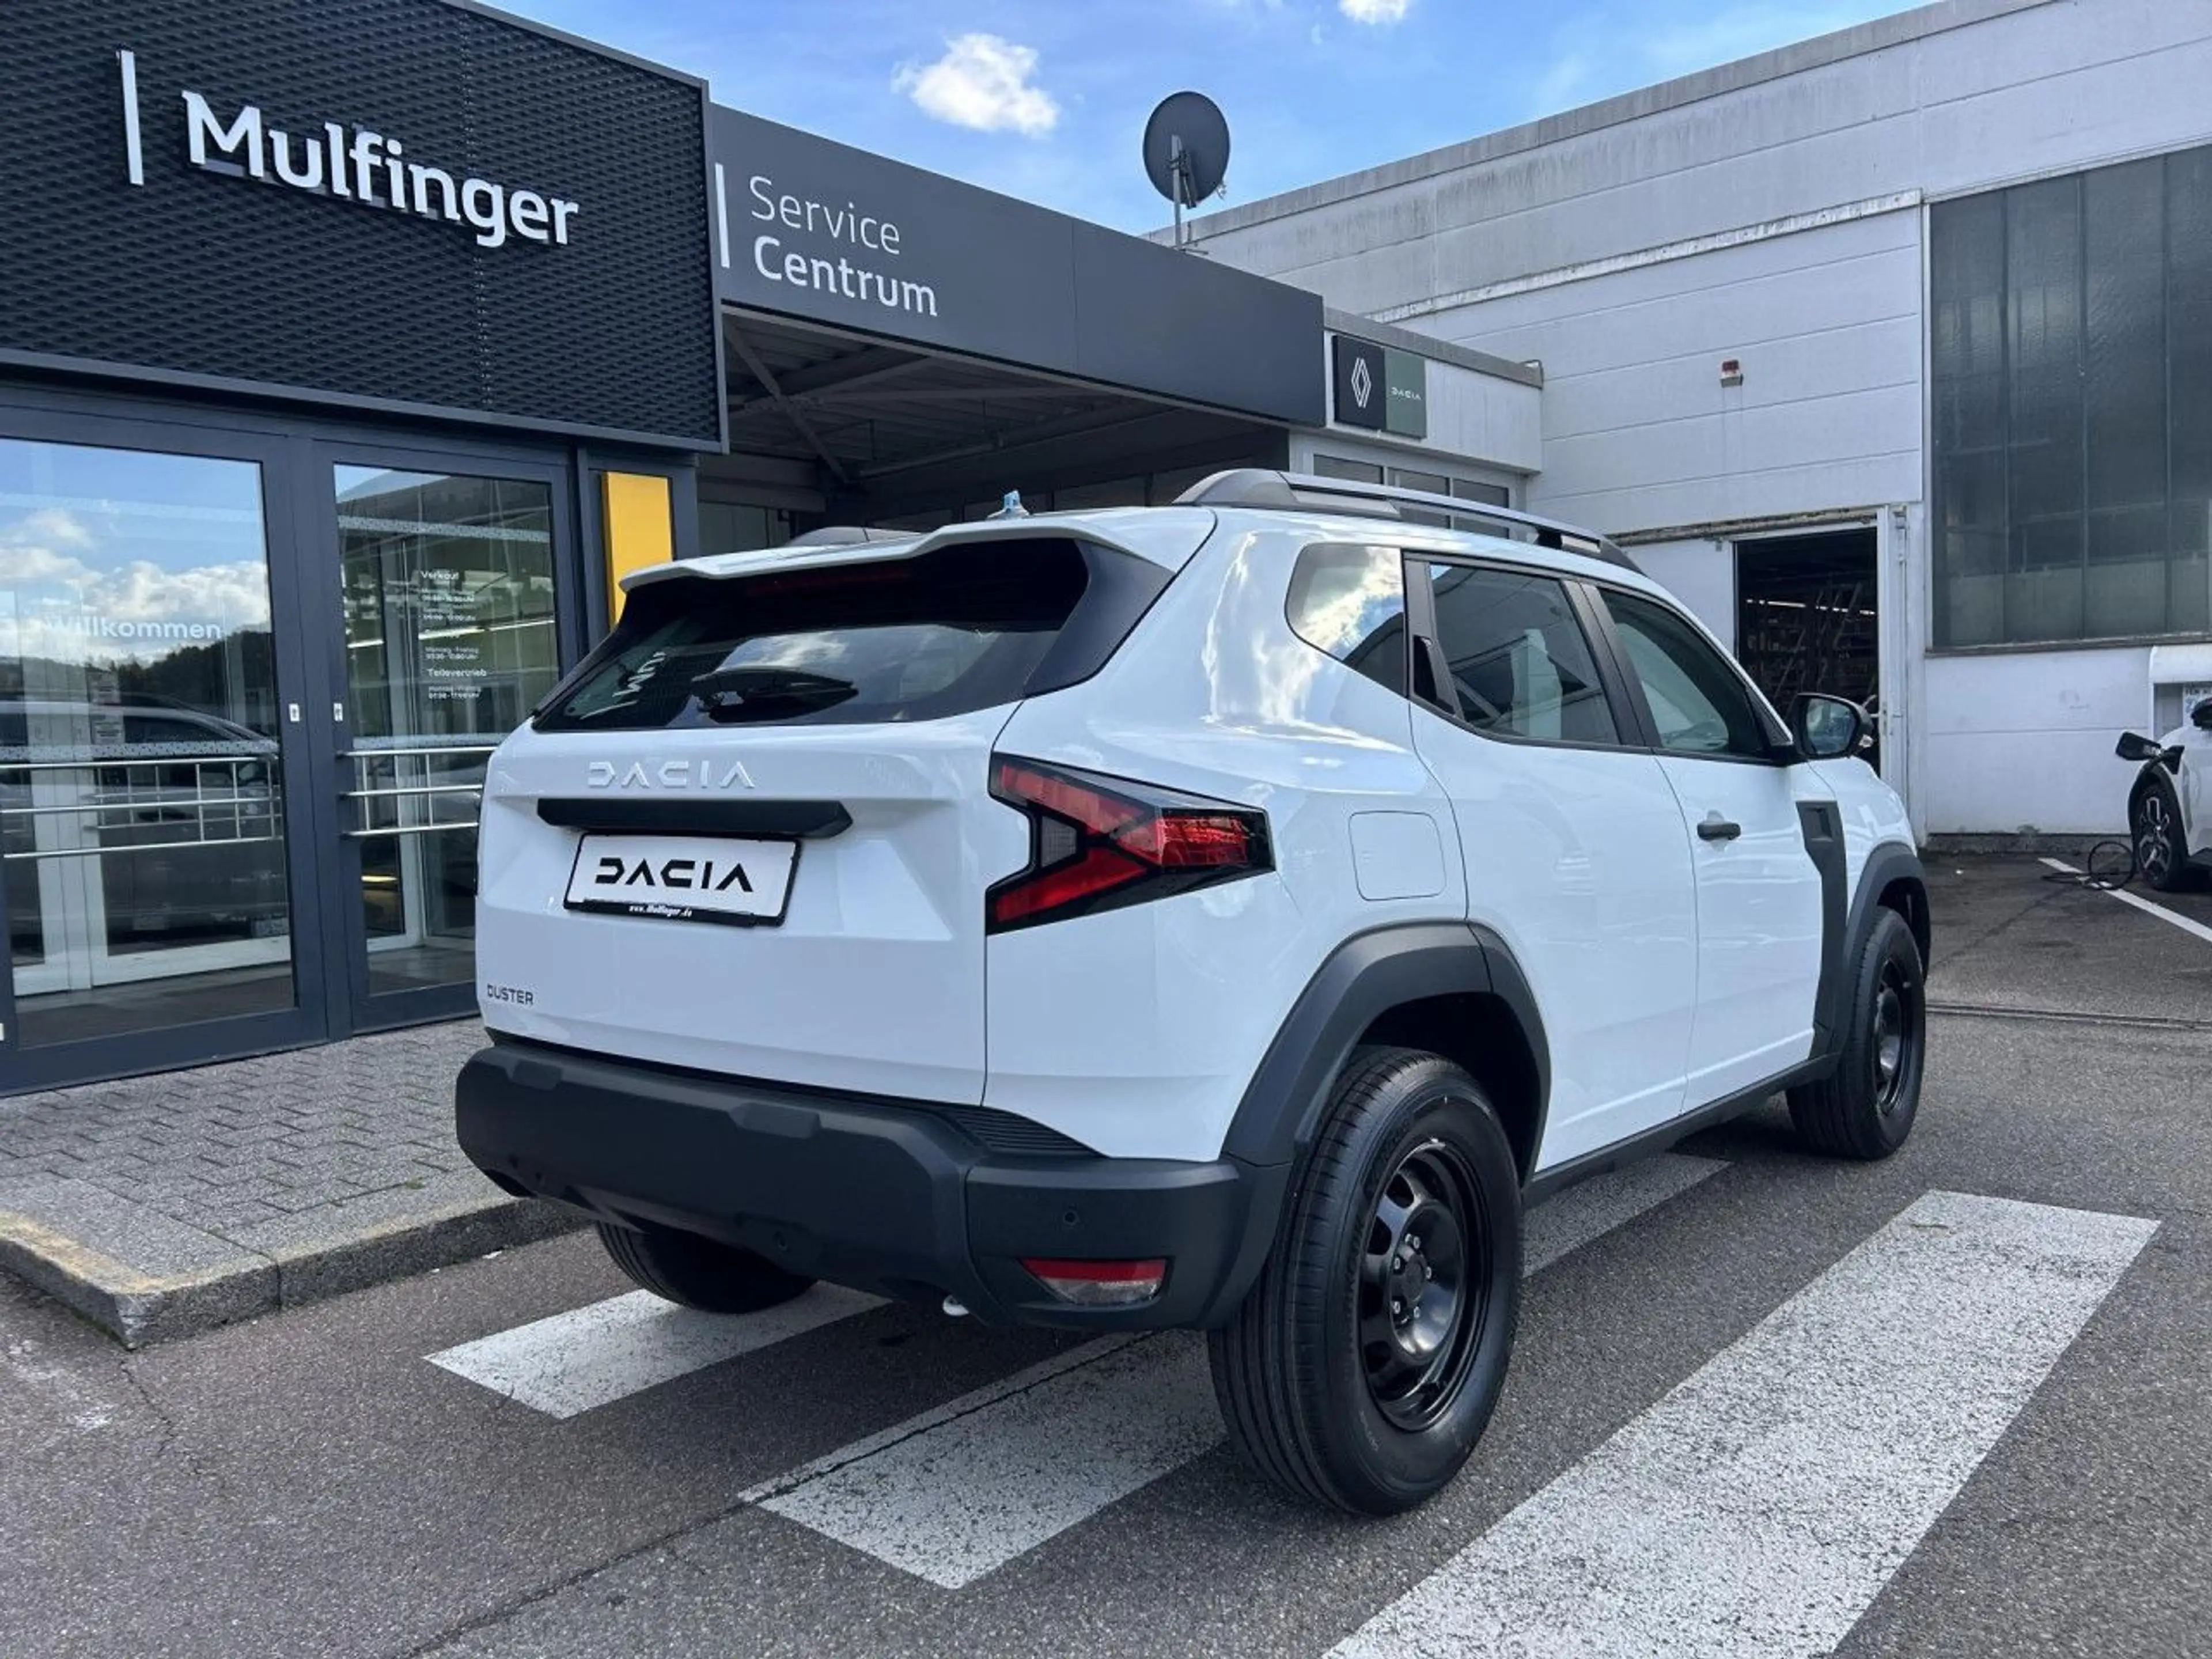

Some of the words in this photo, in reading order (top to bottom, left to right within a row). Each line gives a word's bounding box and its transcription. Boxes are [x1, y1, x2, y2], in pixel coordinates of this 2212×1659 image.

[181, 90, 579, 248] Mulfinger
[749, 176, 900, 255] Service
[754, 235, 938, 317] Centrum
[1391, 387, 1422, 400] DACIA
[588, 760, 756, 789] DACIA
[594, 857, 754, 893] DACIA
[487, 983, 533, 1006] DUSTER
